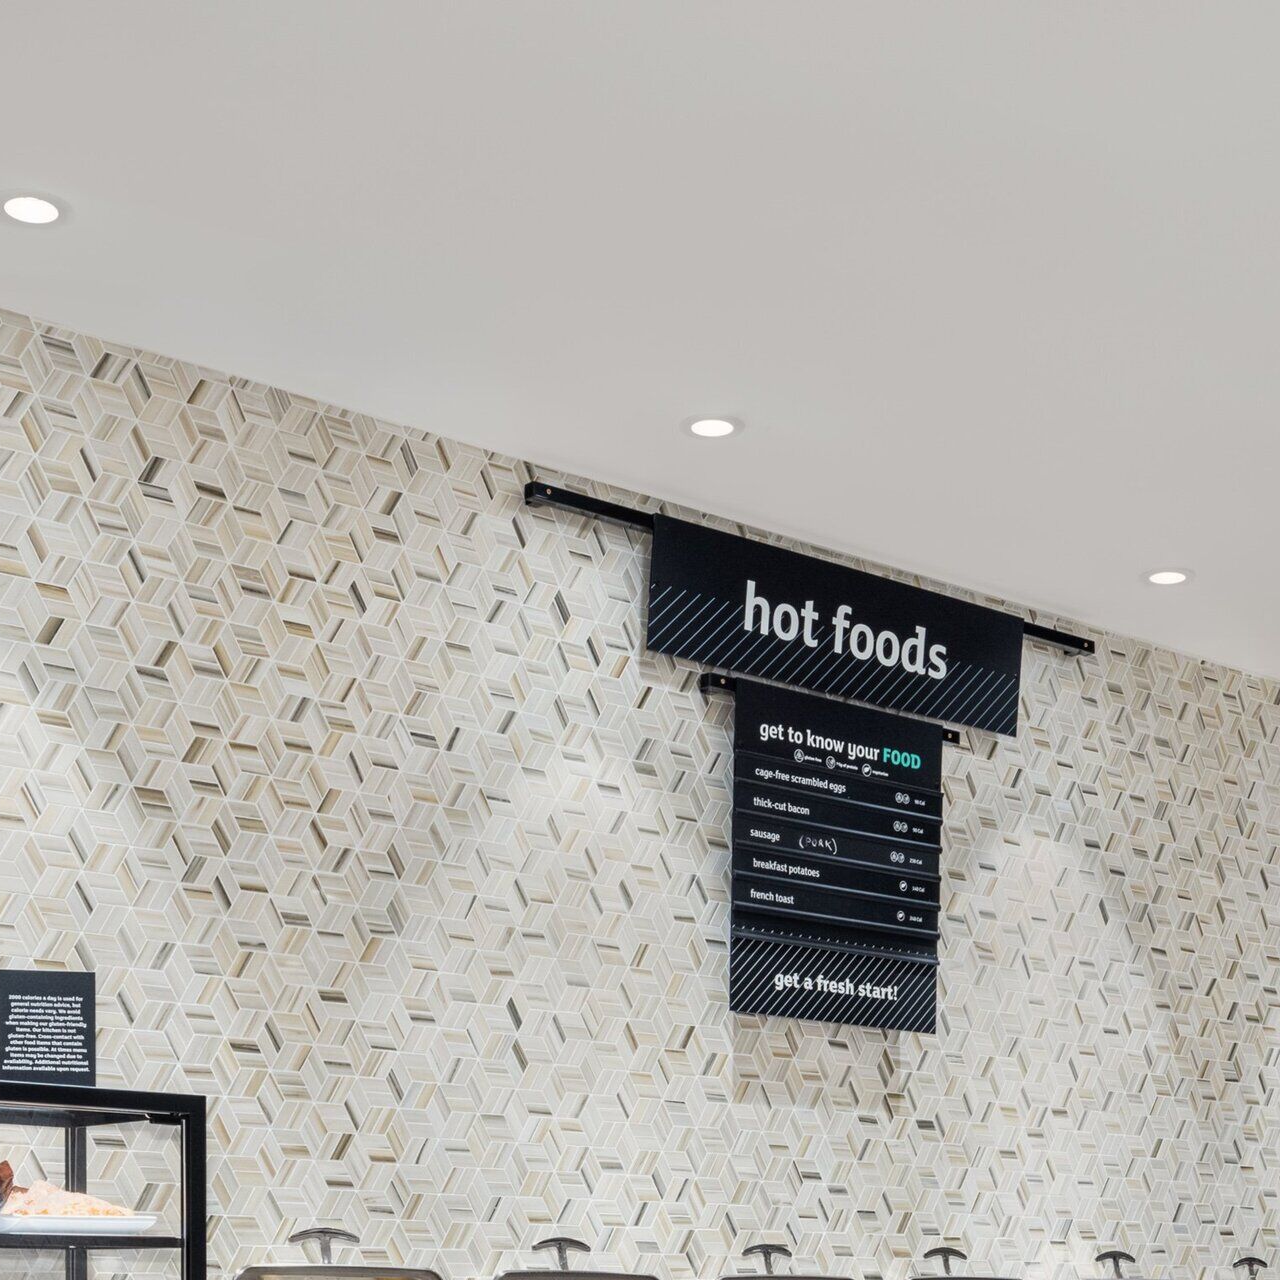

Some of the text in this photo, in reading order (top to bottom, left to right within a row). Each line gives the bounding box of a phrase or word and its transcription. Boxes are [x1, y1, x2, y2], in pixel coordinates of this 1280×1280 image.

[743, 580, 948, 681] hot foods
[760, 723, 921, 769] get to know your FOOD
[755, 767, 846, 794] cage-free scrambled eggs
[753, 796, 810, 816] thick-cut bacon
[750, 827, 780, 842] sausage
[799, 835, 838, 855] (PORK)
[753, 858, 820, 878] breakfast potatoes
[750, 889, 794, 905] french toast
[774, 972, 898, 1001] get a fresh start!
